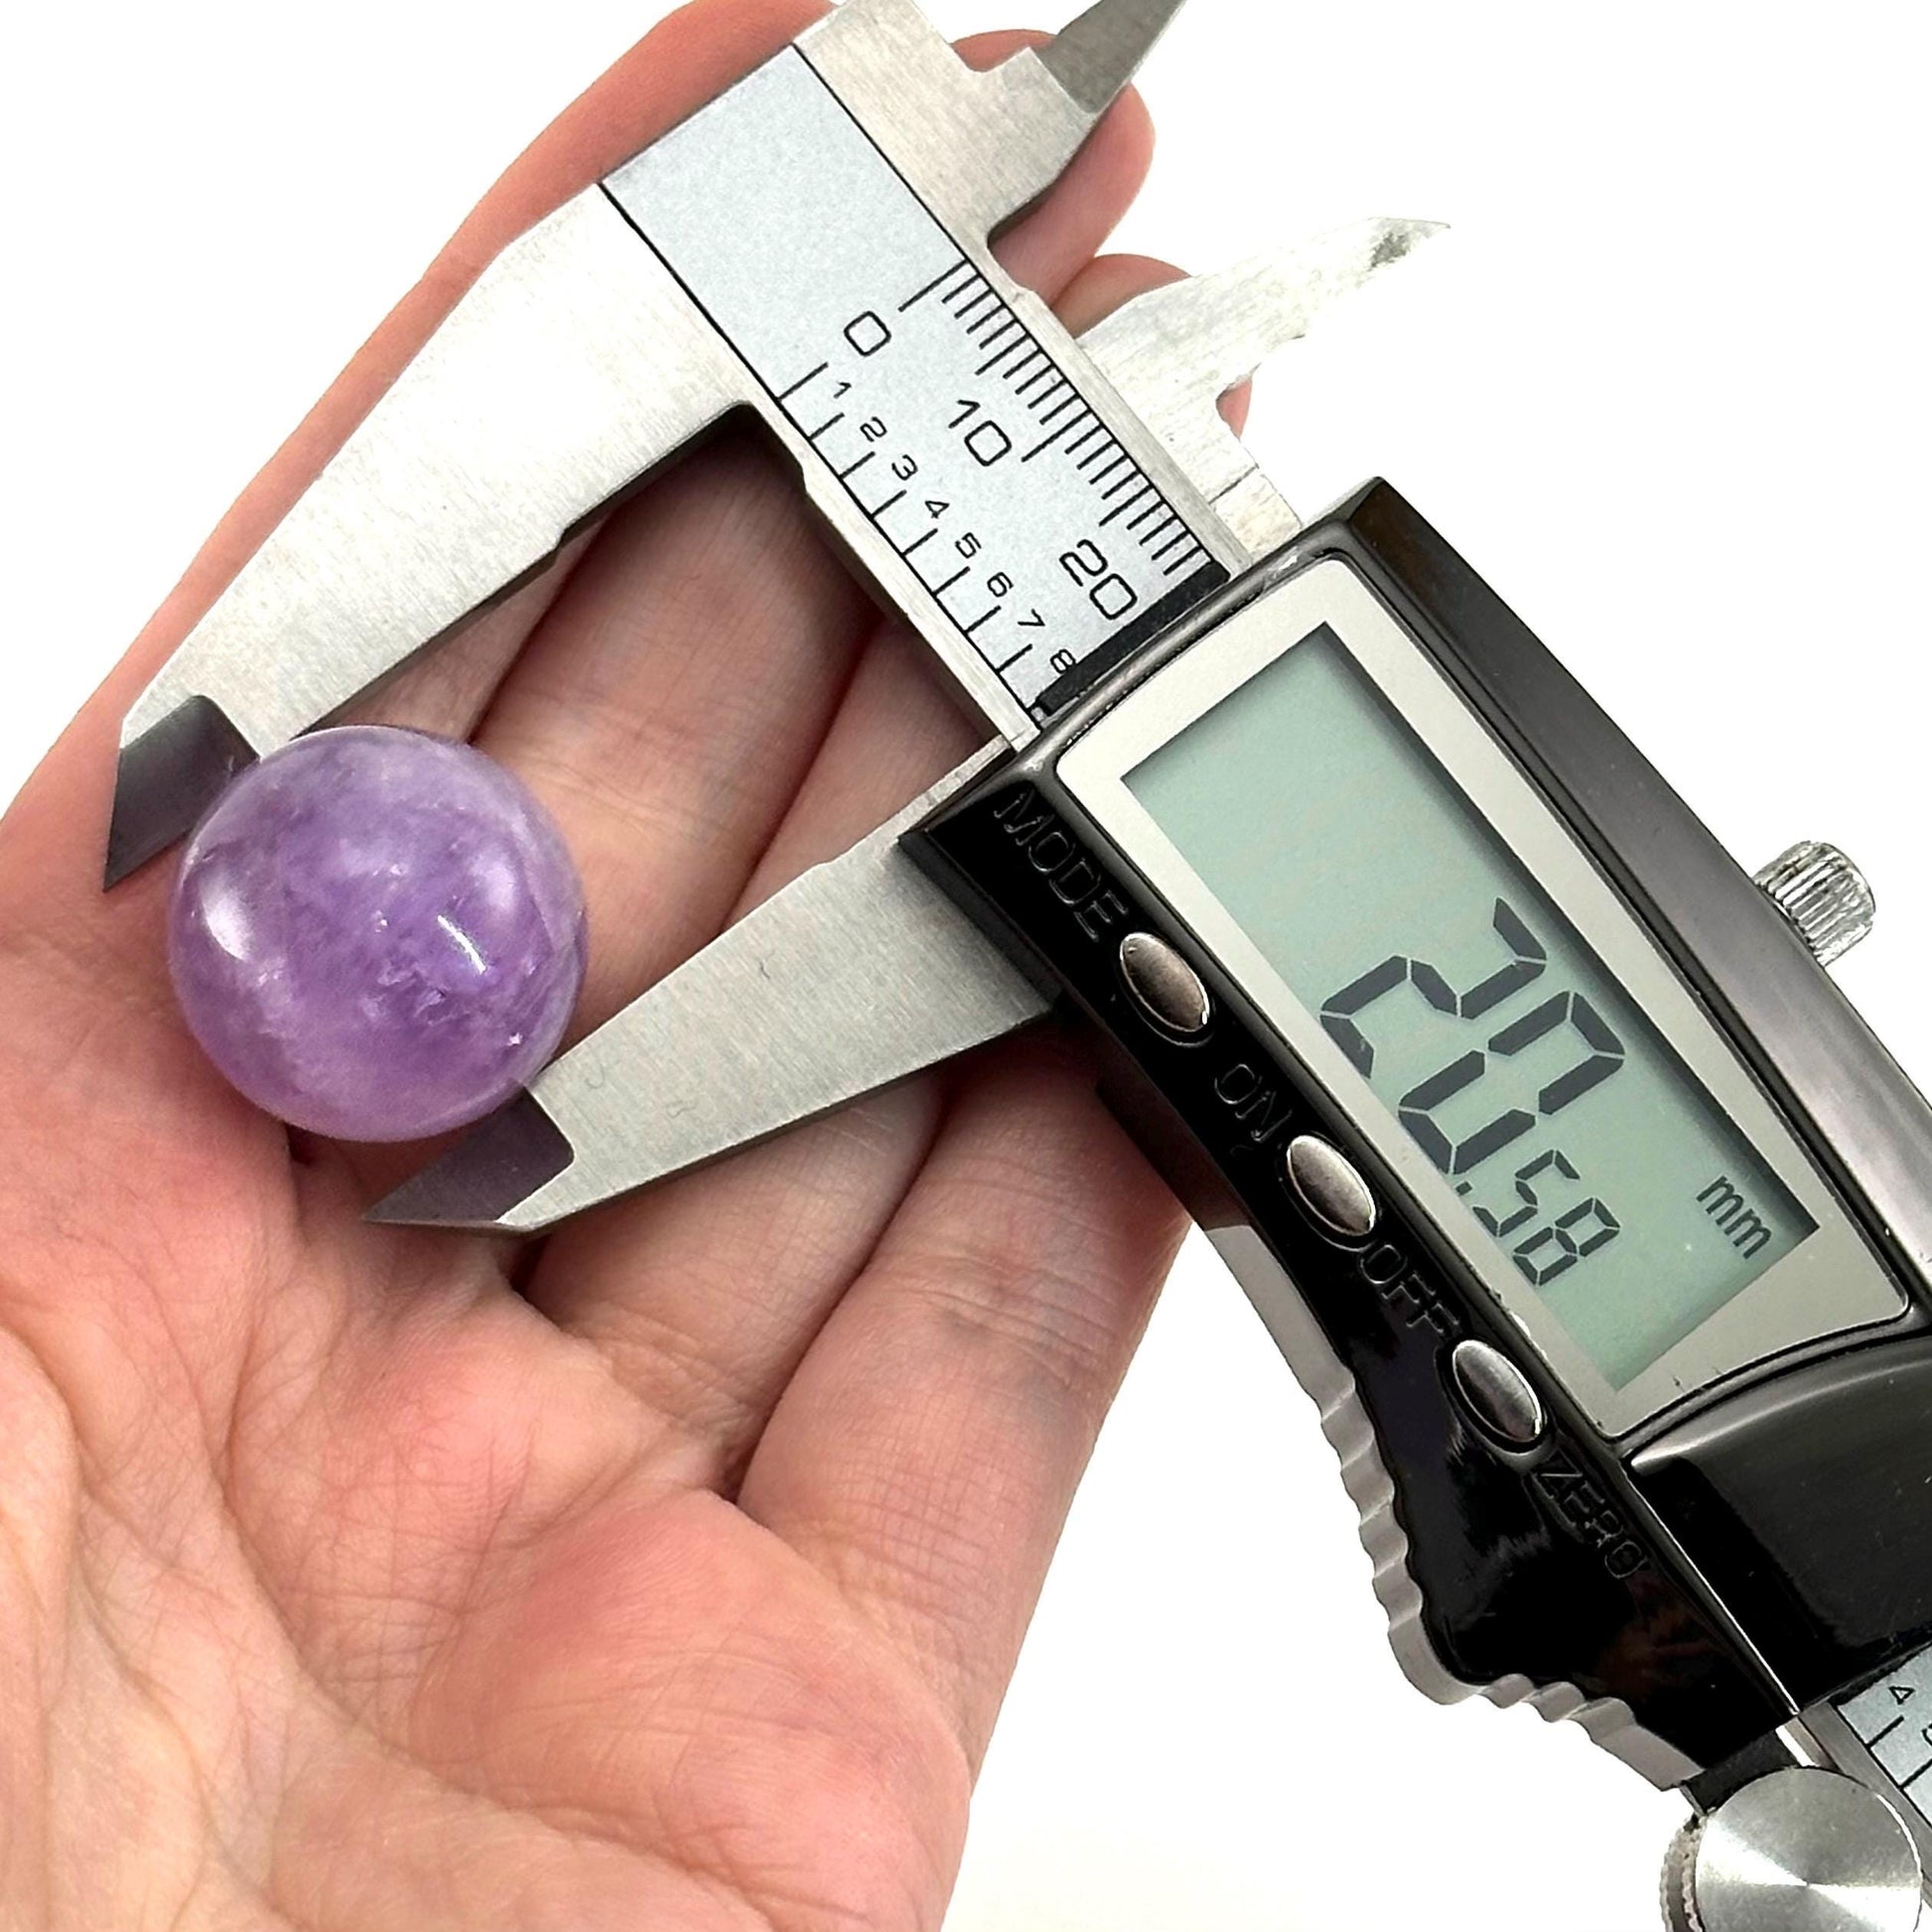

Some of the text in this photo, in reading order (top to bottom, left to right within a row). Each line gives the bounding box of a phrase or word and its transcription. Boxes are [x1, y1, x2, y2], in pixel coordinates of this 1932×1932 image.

[832, 380, 1077, 674] 1 2 3 4 5 6 7 8
[844, 311, 1138, 621] 0 10 20
[993, 788, 1129, 941] MODE
[1213, 1062, 1293, 1143] ON
[1320, 897, 1773, 1287] 20.58 mm
[1360, 1244, 1460, 1334] OFF
[1530, 1448, 1649, 1580] ZERO
